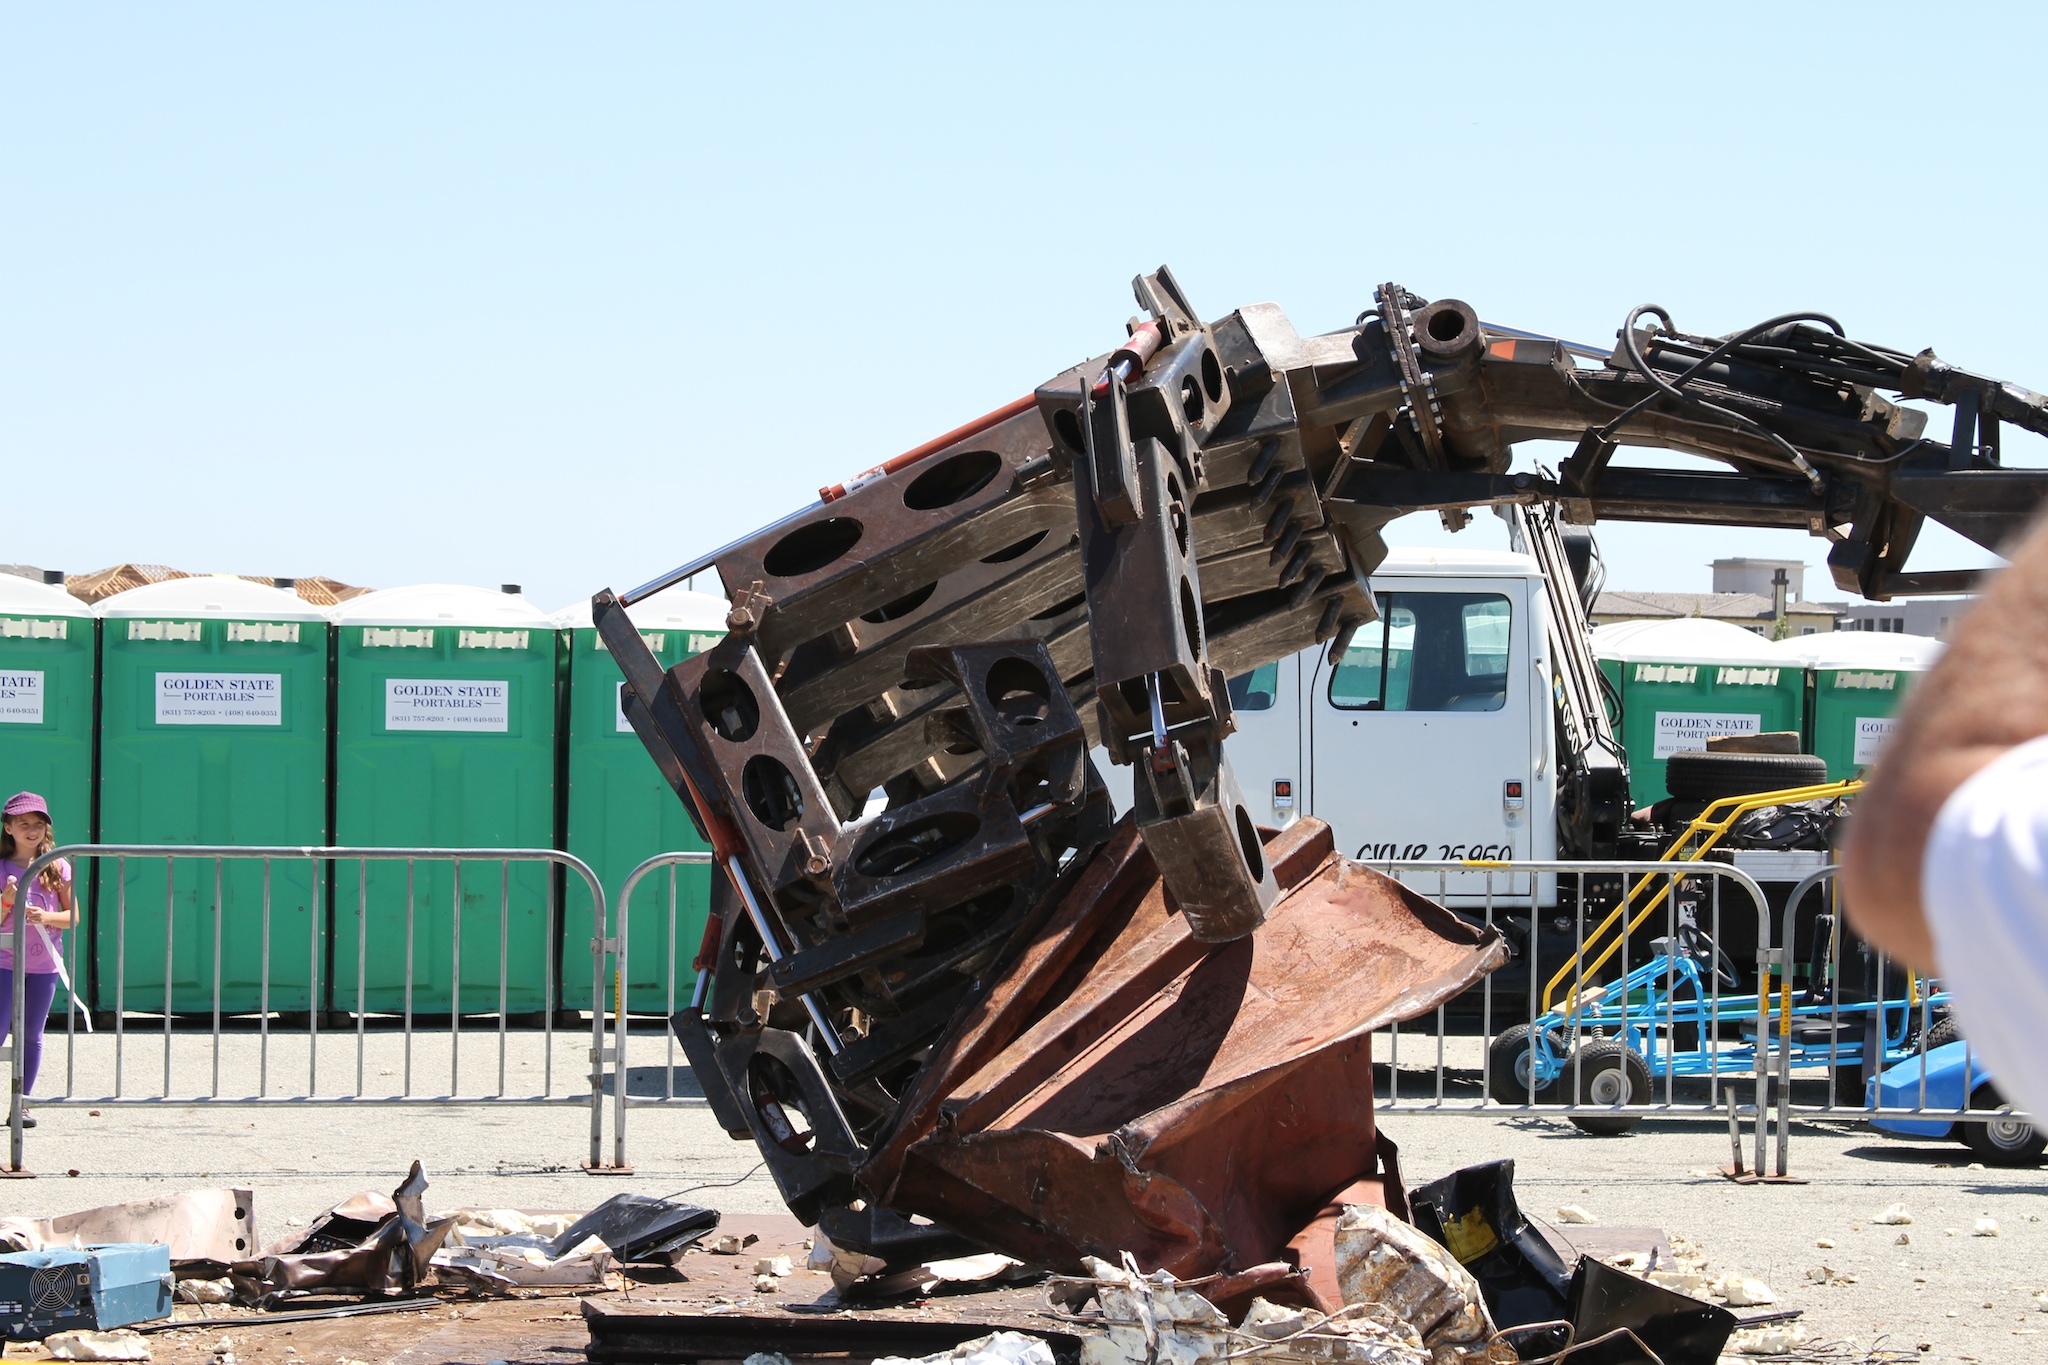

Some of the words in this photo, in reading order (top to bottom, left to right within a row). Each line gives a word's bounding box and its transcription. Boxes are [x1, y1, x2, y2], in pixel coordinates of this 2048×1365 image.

[0, 677, 36, 688] TATE
[164, 679, 224, 690] GOLDEN
[229, 680, 274, 690] STATE
[184, 692, 255, 701] PORTABLES
[394, 685, 453, 697] GOLDEN
[458, 687, 502, 697] STATE
[413, 698, 482, 708] PORTABLES
[1661, 718, 1712, 728] GOLDEN
[1716, 720, 1754, 730] STATE
